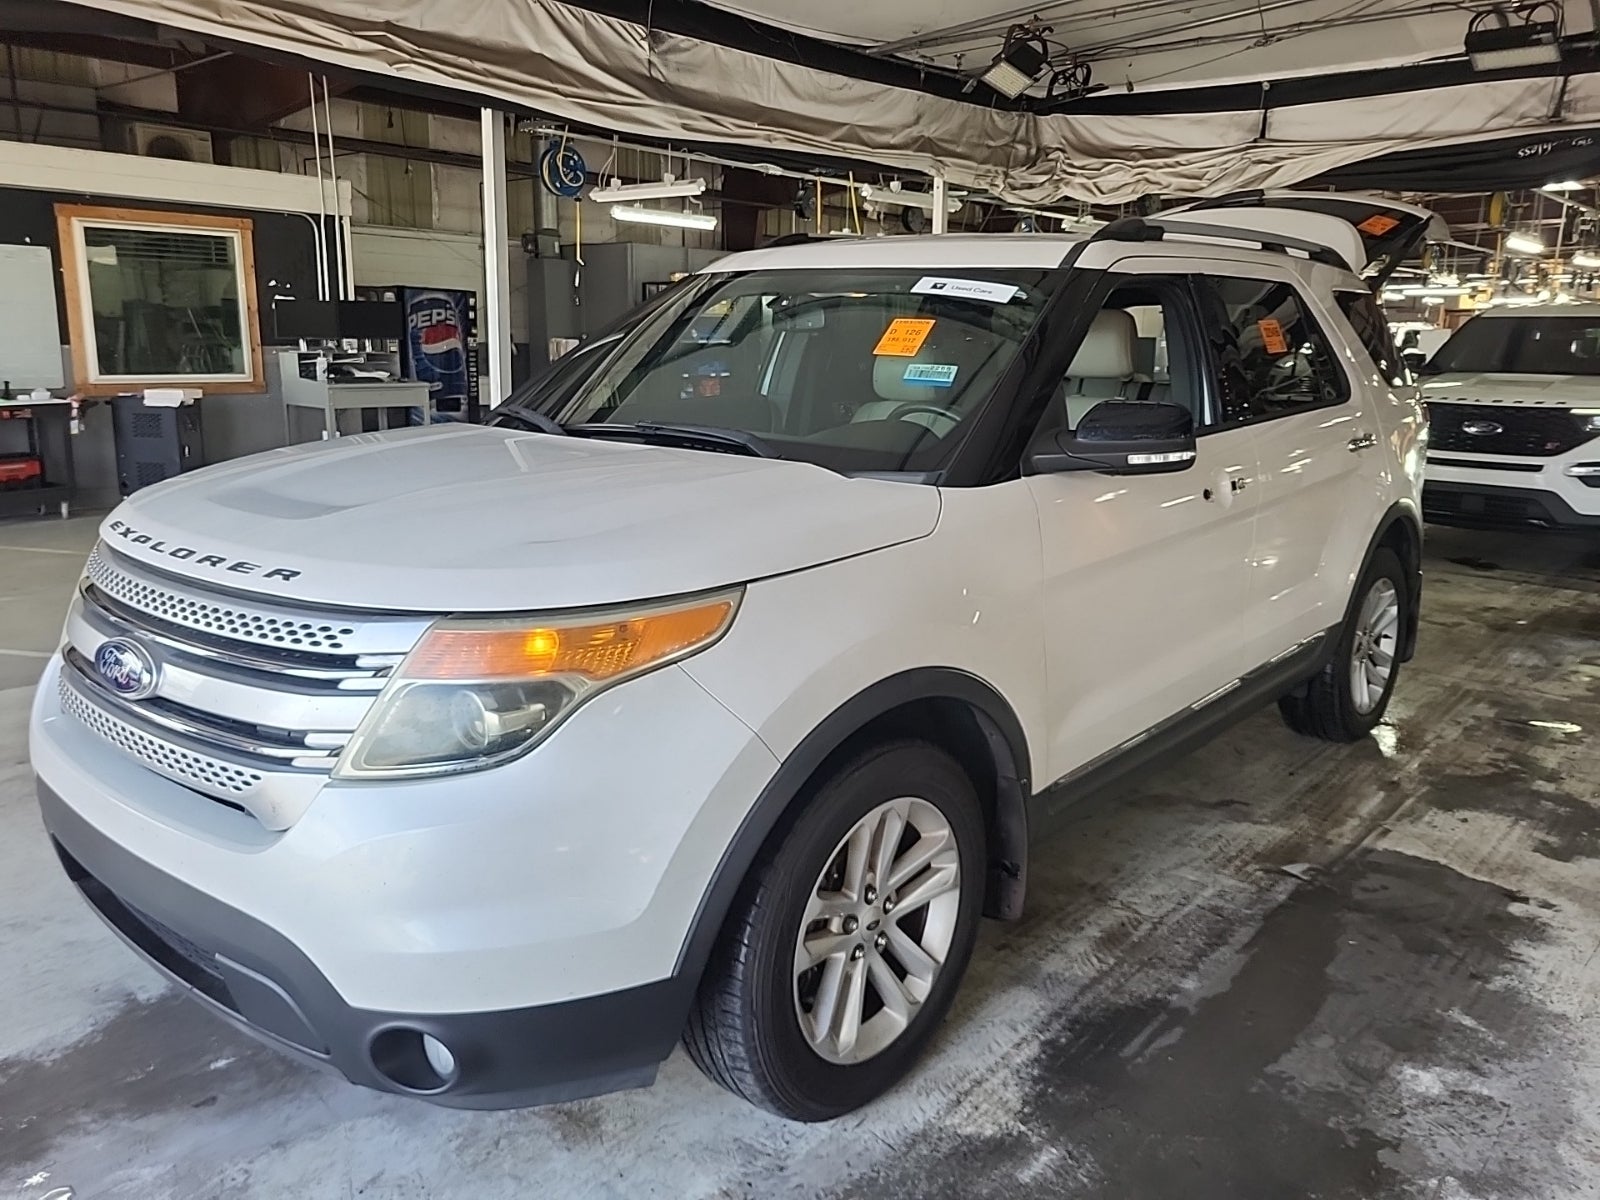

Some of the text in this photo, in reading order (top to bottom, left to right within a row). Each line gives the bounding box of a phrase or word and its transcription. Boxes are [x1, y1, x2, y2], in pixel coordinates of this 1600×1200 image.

[951, 284, 972, 292] Used
[108, 520, 302, 581] EXPLORER
[99, 647, 133, 685] Ford
